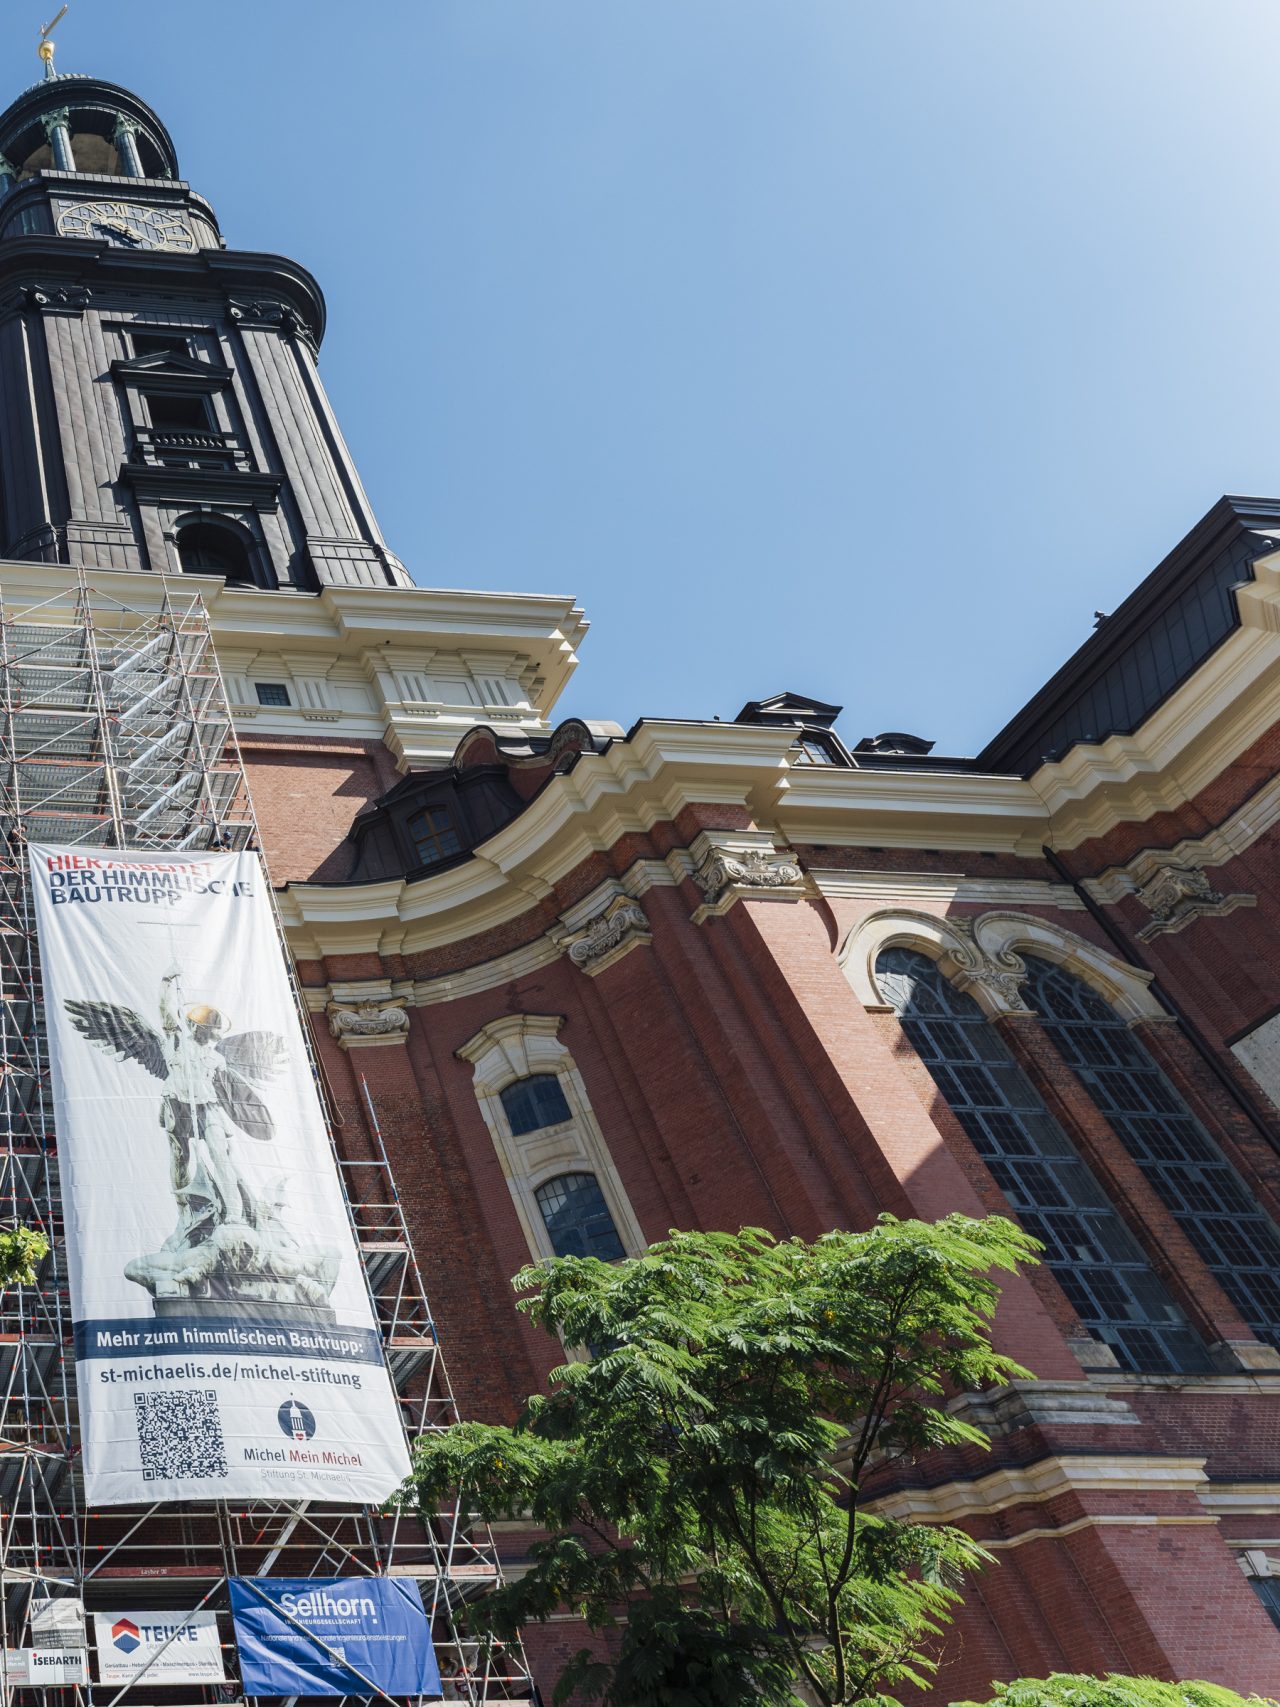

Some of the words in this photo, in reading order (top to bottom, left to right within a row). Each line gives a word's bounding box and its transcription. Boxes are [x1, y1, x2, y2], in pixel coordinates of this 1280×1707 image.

[47, 855, 100, 872] HIER
[50, 870, 96, 887] DER
[103, 869, 255, 897] HIMMLISCHE
[51, 885, 182, 905] BAUTRUPP
[97, 1330, 140, 1348] Mehr
[144, 1331, 178, 1346] zum
[183, 1327, 286, 1347] himmlischen
[290, 1331, 364, 1355] Bautrupp:
[100, 1362, 362, 1390] st-michaelis.de/michel-stiftung
[244, 1448, 286, 1463] Michel
[289, 1450, 319, 1464] Mein
[322, 1451, 362, 1467] Michel
[261, 1468, 296, 1482] Stiftung
[280, 1592, 376, 1617] Sellhorn
[141, 1625, 198, 1642] TEUPE
